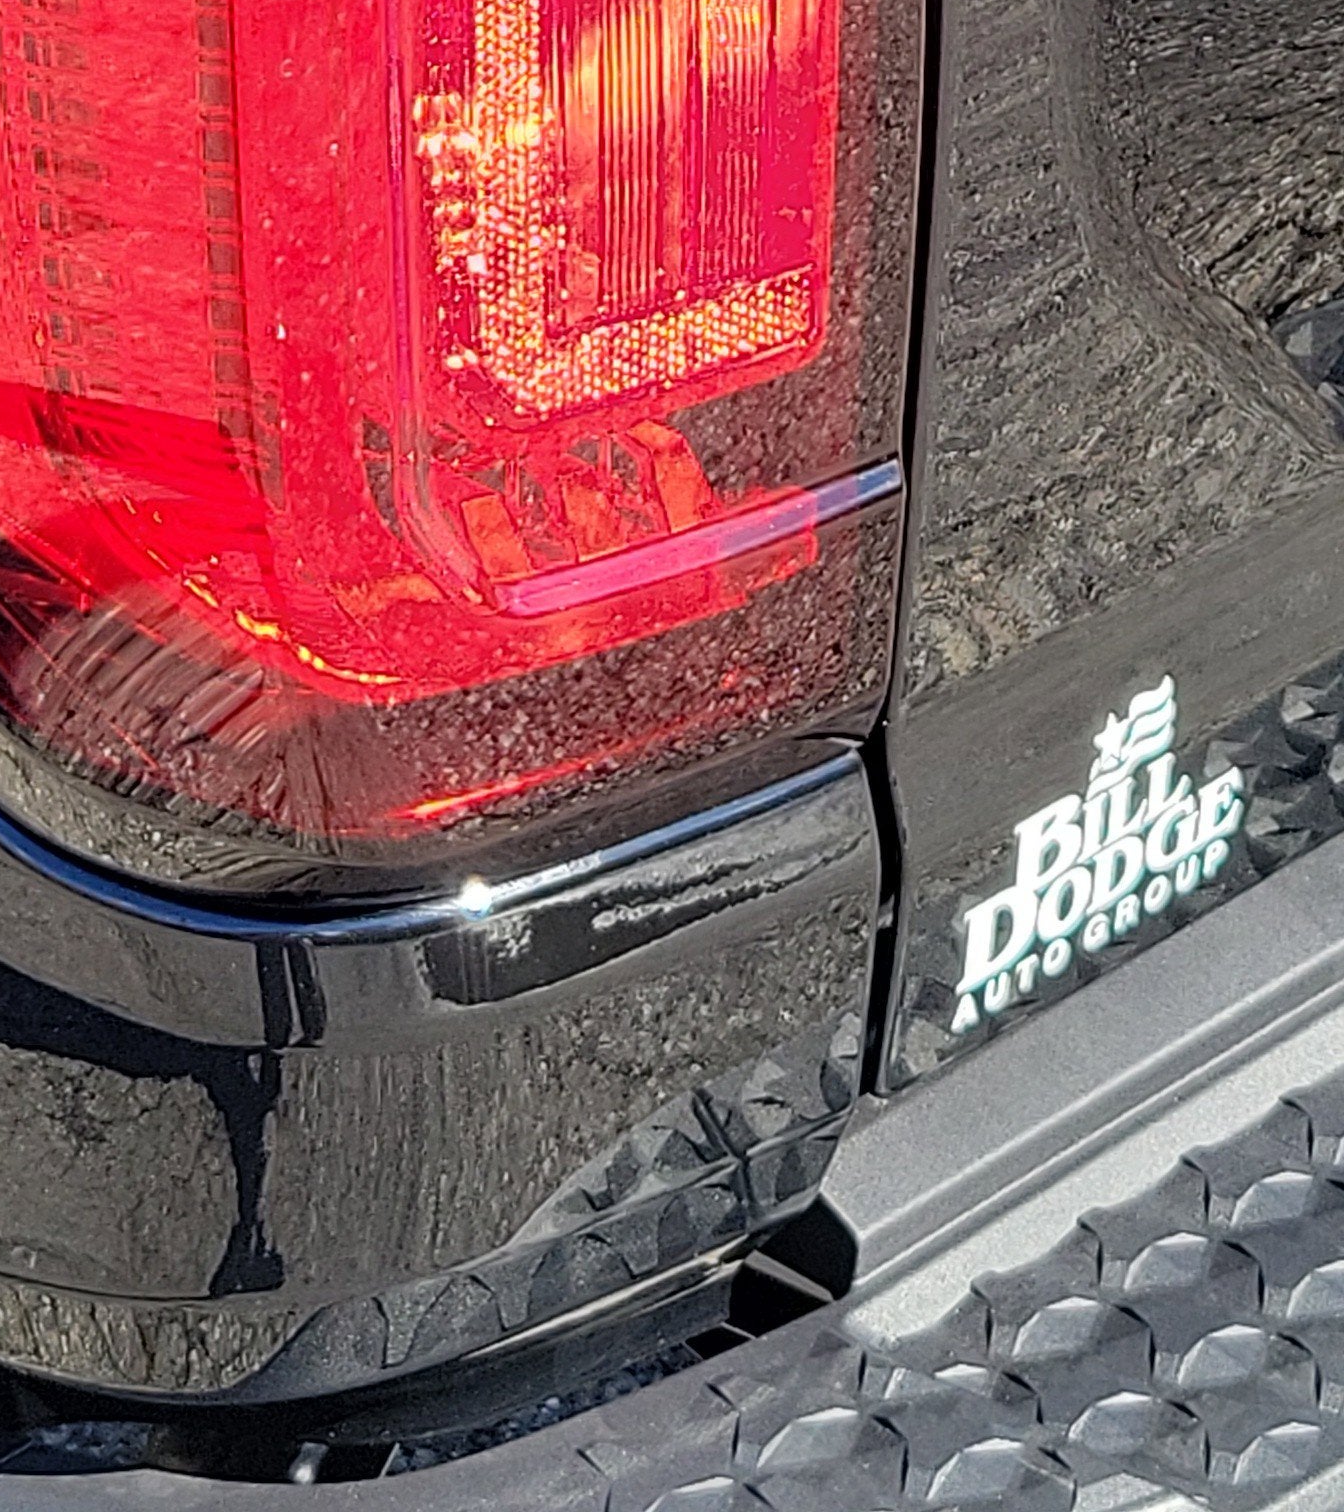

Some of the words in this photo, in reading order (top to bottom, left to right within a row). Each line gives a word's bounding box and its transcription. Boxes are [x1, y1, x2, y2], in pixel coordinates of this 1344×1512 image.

[955, 766, 1245, 994] DODGE
[1013, 751, 1193, 891] BILL
[950, 938, 1073, 1034] AUTO
[1083, 838, 1230, 954] GROUP
